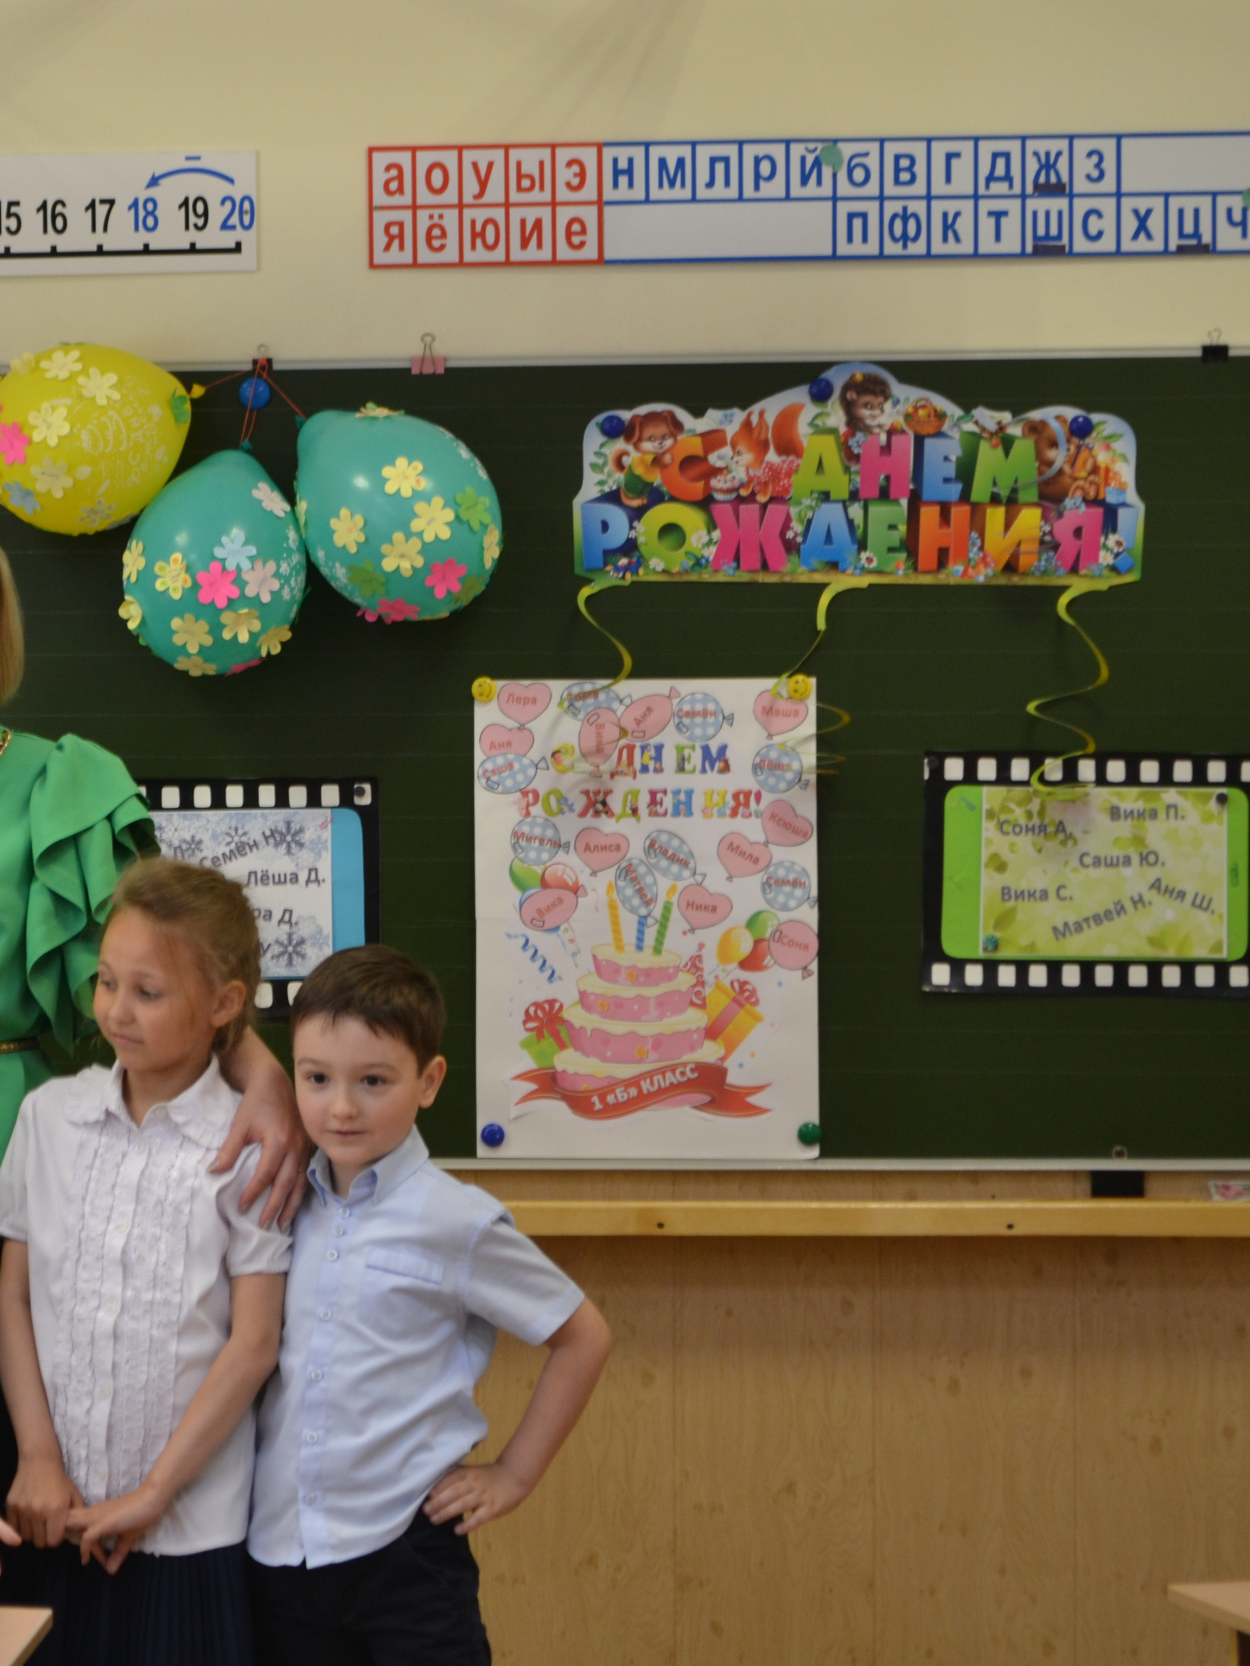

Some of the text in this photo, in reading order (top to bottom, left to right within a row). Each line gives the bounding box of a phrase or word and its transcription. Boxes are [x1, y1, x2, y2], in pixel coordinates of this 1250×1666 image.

[383, 146, 1106, 198] а о у ы э н м л р й б в г д ж з
[36, 198, 67, 235] 16
[84, 198, 116, 234] 17
[127, 196, 159, 233] 18
[178, 195, 209, 232] 19
[219, 195, 255, 232] 20
[383, 206, 1248, 252] я ё ю и е п ф к т ш с х ц ч
[660, 428, 1040, 503] С ДНЕМ
[581, 500, 1140, 573] РОЖДЕНИЯ!
[506, 693, 538, 706] Лера
[633, 705, 654, 728] Аня
[761, 705, 801, 718] Маша
[489, 738, 513, 752] Аня
[482, 760, 515, 779] Саша
[550, 742, 731, 781] С ДНЕМ
[516, 788, 763, 824] РОЖДЕНИЯ!
[1109, 803, 1186, 822] Вика П.
[769, 810, 810, 840] Ксюша
[1000, 819, 1048, 837] Соня
[513, 831, 562, 850] Мигель
[583, 841, 622, 855] Алиса
[648, 838, 691, 868] Владик
[726, 841, 761, 866] Мила
[1079, 850, 1165, 869] Саша Ю.
[245, 867, 326, 888] Лёша Д.
[624, 862, 655, 908] Матвей
[1001, 884, 1074, 902] Вика С.
[1148, 876, 1216, 915] Аня Ш.
[277, 907, 299, 927] Д.
[535, 896, 565, 919] Вика
[686, 899, 718, 914] Ника
[1052, 892, 1153, 942] Матвей Н.
[779, 936, 810, 952] Соня
[591, 1063, 699, 1112] 1 «Б» КЛАСС
